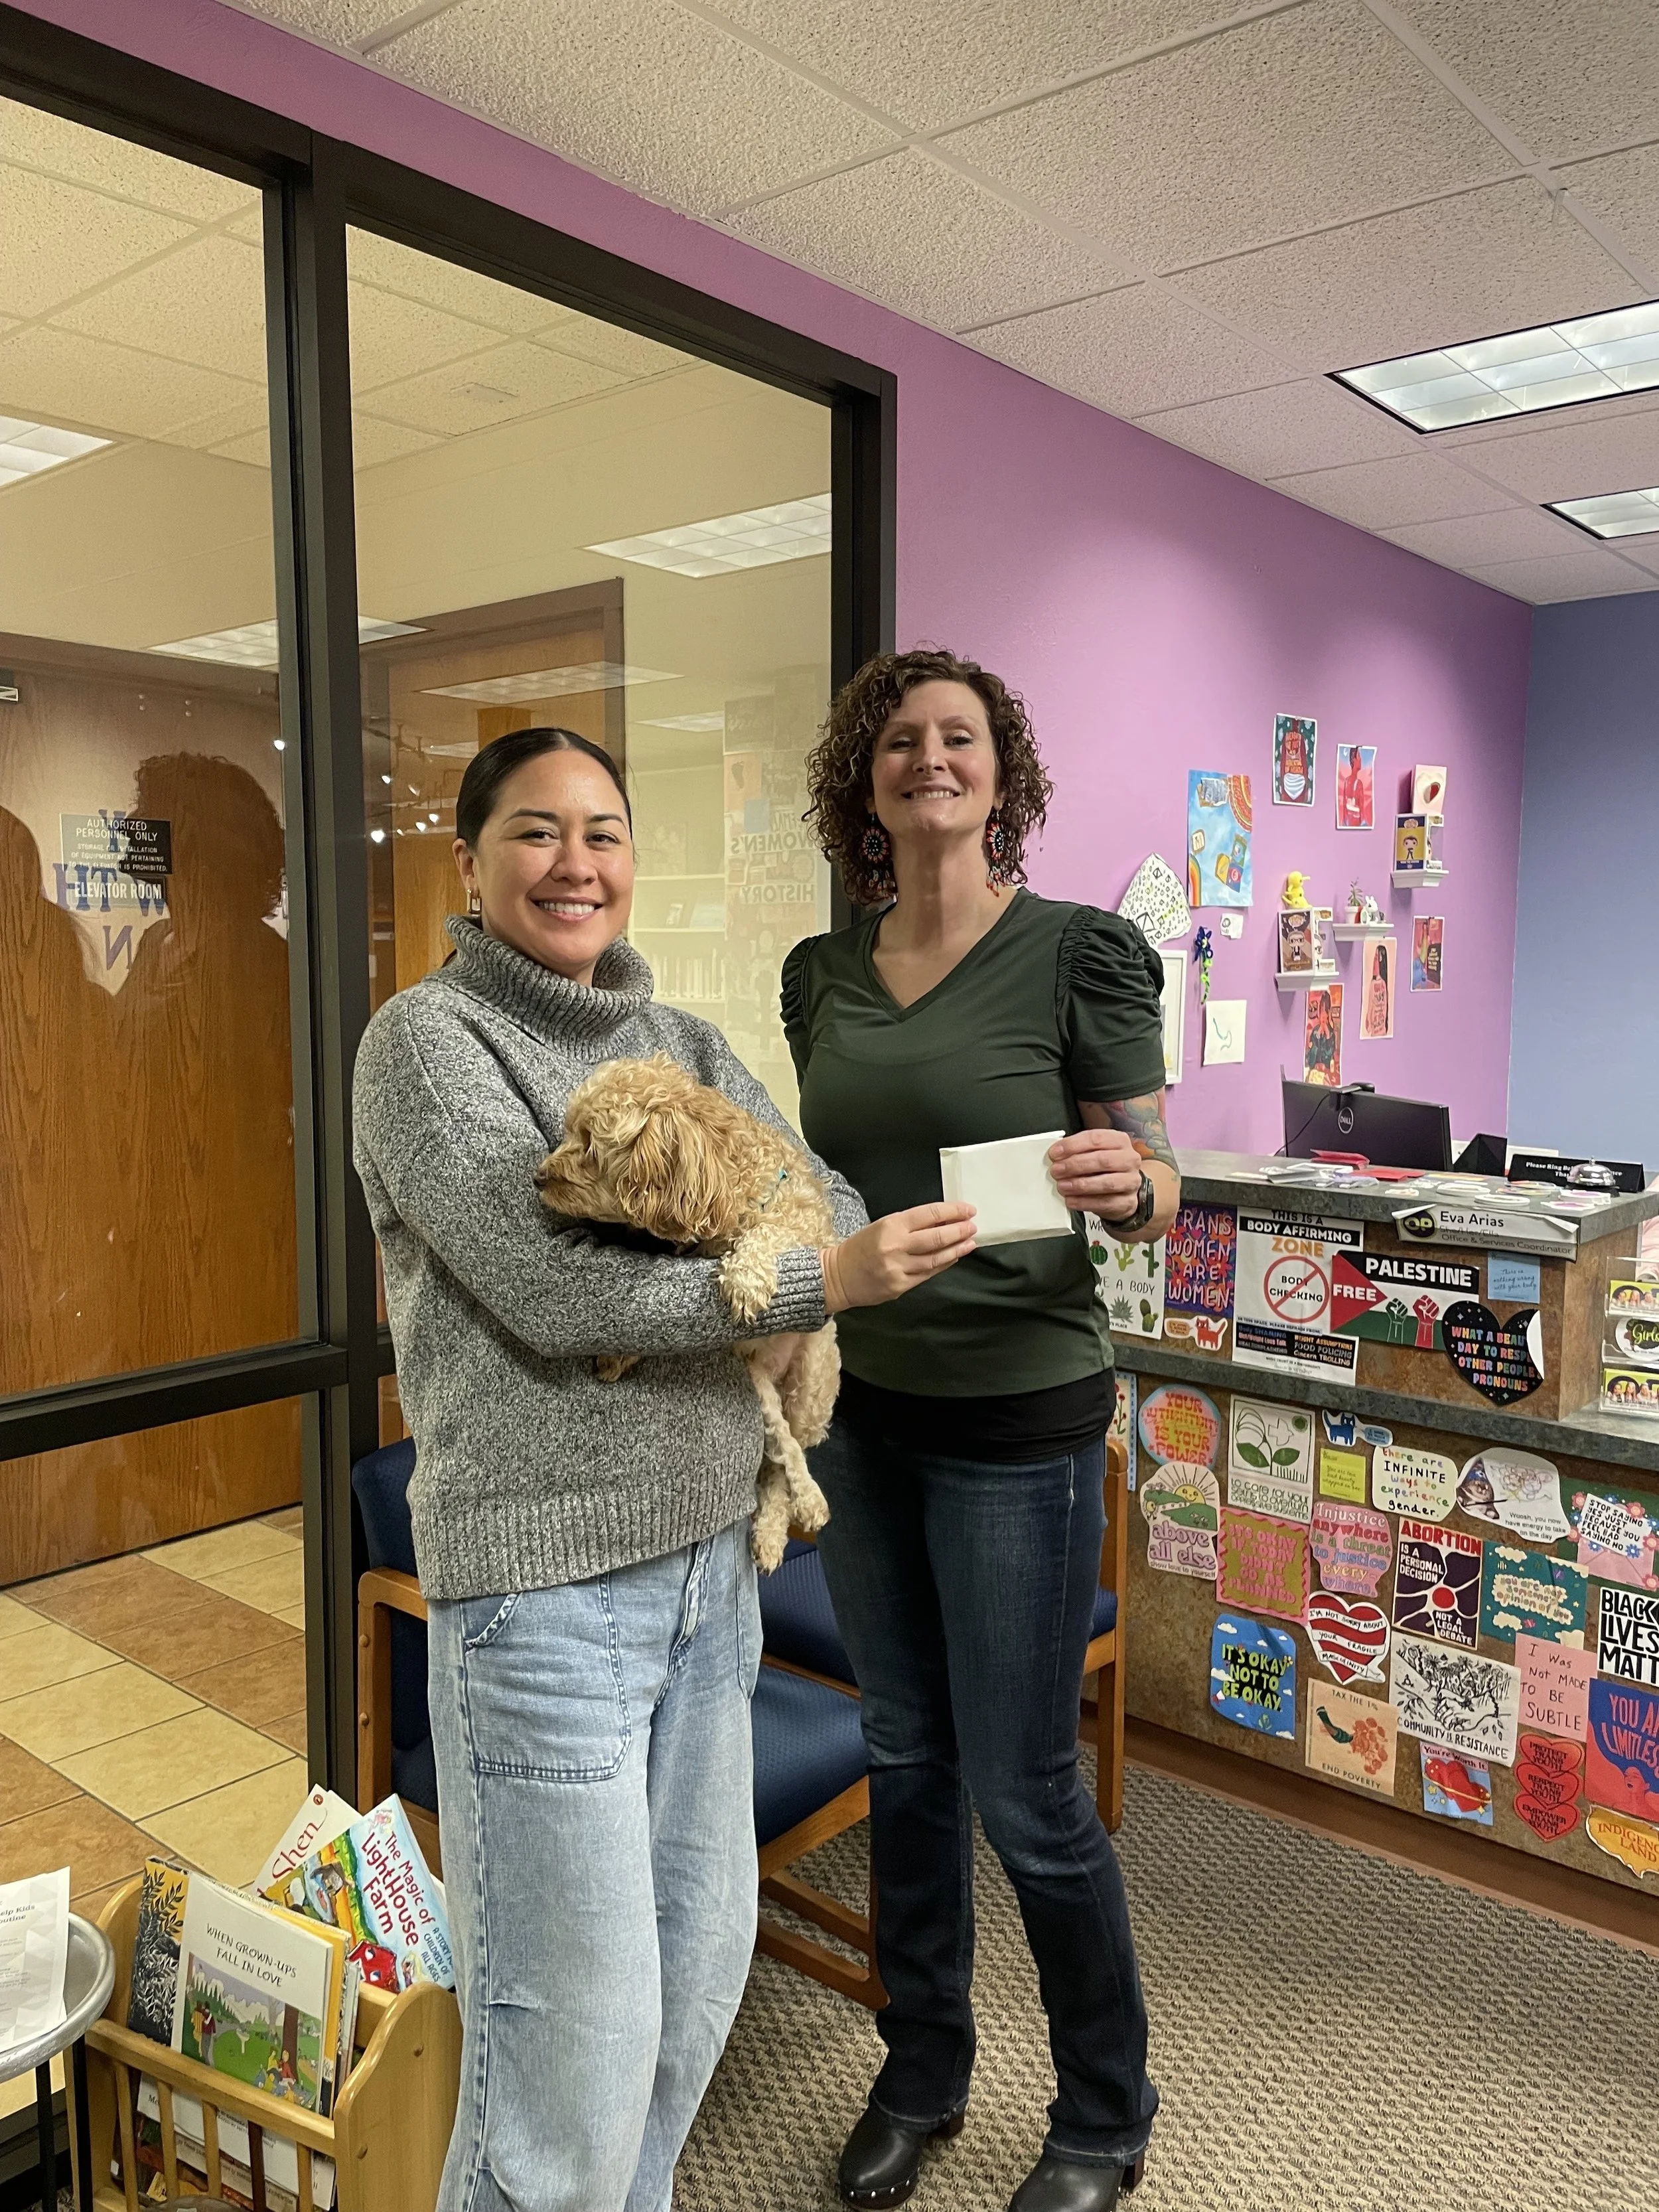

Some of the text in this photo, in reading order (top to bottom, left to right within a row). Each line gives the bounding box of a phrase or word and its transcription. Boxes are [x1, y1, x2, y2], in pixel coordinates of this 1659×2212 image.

[76, 828, 131, 840] PERSONNEL
[87, 819, 147, 831] AUTHORIZED
[75, 882, 161, 899] ELEVATOR ROOM
[1340, 1115, 1351, 1125] DELL
[1174, 1208, 1232, 1235] TRANS
[1271, 1210, 1323, 1225] THIS IS A
[1404, 1217, 1435, 1231] OP
[1440, 1211, 1504, 1227] Eva Arias
[1248, 1220, 1352, 1243] BODY AFFIRMING
[1439, 1225, 1499, 1237] She/Her/Ella
[1168, 1236, 1230, 1262] WOMEN
[1271, 1237, 1325, 1258] ZONE
[1442, 1234, 1468, 1242] Office
[1480, 1238, 1515, 1248] Services
[1517, 1242, 1572, 1254] Coordinator
[1183, 1264, 1218, 1280] ARE
[1366, 1258, 1472, 1287] PALESTINE
[1116, 1280, 1155, 1295] A BODY
[1168, 1281, 1230, 1307] WOMEN
[1333, 1284, 1376, 1301] FREE
[1317, 1339, 1352, 1350] ASSUMPTIONS
[1452, 1326, 1493, 1342] WHAT A
[1295, 1342, 1352, 1359] FOOD POLICING
[1458, 1342, 1497, 1357] DAY TO
[1320, 1355, 1350, 1366] TROLLING
[1458, 1357, 1493, 1371] OTHER
[1473, 1372, 1528, 1391] PRONOUNS
[1166, 1392, 1202, 1413] YOUR
[1155, 1426, 1210, 1451] IS YOUR
[1156, 1441, 1206, 1465] POWER
[1383, 1448, 1443, 1468] there are
[1384, 1461, 1445, 1483] INFINITE
[1391, 1475, 1436, 1489] ways to
[1244, 1482, 1269, 1495] care
[1381, 1486, 1449, 1507] experience
[1317, 1503, 1386, 1527] Injustice
[1534, 1515, 1546, 1524] you
[1587, 1507, 1627, 1528] YES JUST
[1590, 1500, 1643, 1527] STOP SAYING
[1152, 1520, 1209, 1548] above
[1313, 1518, 1388, 1543] anywhere
[1505, 1519, 1522, 1528] have
[1522, 1522, 1544, 1532] energy
[1582, 1520, 1619, 1540] FEEL BAD
[1585, 1513, 1640, 1542] BECAUSE YOU
[1343, 1536, 1391, 1558] threat
[1401, 1520, 1482, 1556] ABORTION
[1581, 1528, 1623, 1550] SAYING NO
[1149, 1541, 1216, 1569] all else
[1251, 1541, 1295, 1564] TODAY
[1314, 1545, 1387, 1570] to justice
[1401, 1543, 1419, 1558] IS A
[1190, 1566, 1215, 1578] yourself
[1400, 1554, 1444, 1575] PERSONAL
[1400, 1564, 1438, 1584] DECISION
[1240, 1567, 1285, 1587] GO AS
[1229, 1578, 1295, 1604] PLANNED
[1497, 1591, 1536, 1608] opinion
[1602, 1589, 1656, 1623] BLACK
[1325, 1610, 1338, 1619] NOT
[1341, 1617, 1360, 1631] SORRY
[1435, 1611, 1462, 1627] NOT A
[1437, 1619, 1465, 1635] LEGAL
[1319, 1631, 1377, 1654] YOUR FRAGILE
[1440, 1630, 1473, 1647] DEBATE
[1601, 1613, 1659, 1653] LIVES
[1249, 1652, 1286, 1676] OKAY
[1323, 1653, 1364, 1672] MASCULINITY
[1528, 1643, 1572, 1668] I Was
[1230, 1664, 1279, 1691] NOT TO
[1530, 1666, 1587, 1690] Not MADE
[1223, 1680, 1240, 1698] BE
[1333, 1689, 1378, 1710] TAX THE 1%
[1520, 1682, 1565, 1704] TO BE
[1526, 1702, 1581, 1731] SUBTLE
[1609, 1693, 1639, 1728] YOU
[1397, 1717, 1509, 1759] COMMUNITY IS RESISTANCE
[1424, 1746, 1476, 1767] You're Worth
[1530, 1741, 1567, 1759] PROTECT
[1322, 1763, 1381, 1789] END POVERTY
[1528, 1775, 1564, 1791] RESPECT
[1522, 1805, 1566, 1824] EMPOWER
[272, 1807, 328, 1880] Shen
[1620, 1836, 1656, 1863] LAND
[386, 1831, 435, 1925] The Magic of
[361, 1832, 419, 1946] LightHouse
[363, 1876, 394, 1935] Farm
[206, 1923, 297, 1978] WHEN GROWN-UPS
[424, 1933, 444, 1968] CHILDREN
[435, 1933, 451, 1956] STORY
[217, 1947, 283, 1987] FALL IN LOVE
[421, 1951, 441, 1982] ALL AGES
